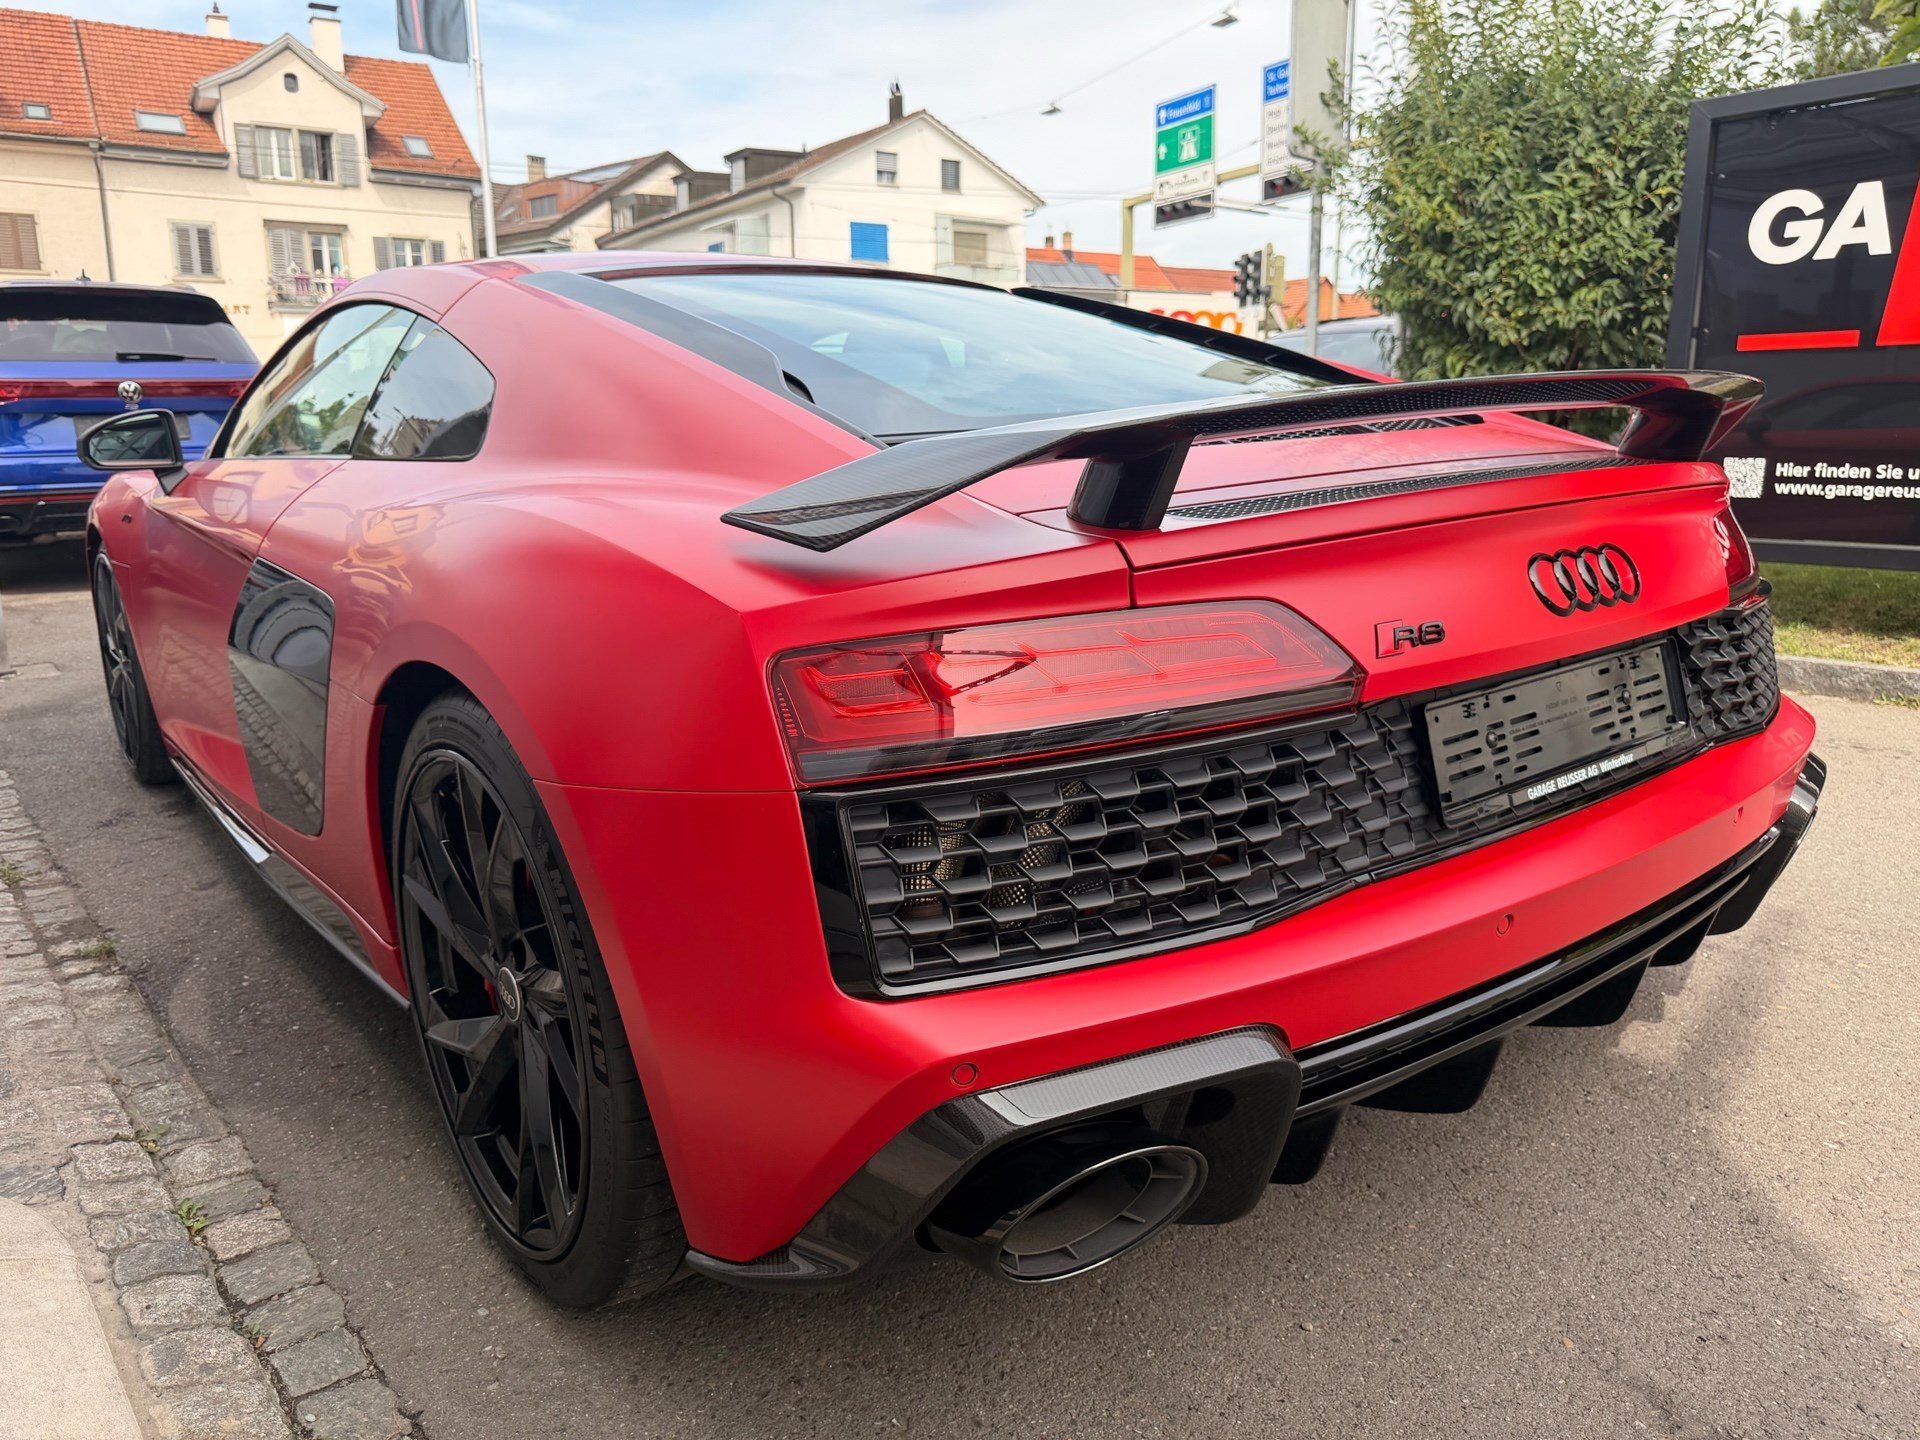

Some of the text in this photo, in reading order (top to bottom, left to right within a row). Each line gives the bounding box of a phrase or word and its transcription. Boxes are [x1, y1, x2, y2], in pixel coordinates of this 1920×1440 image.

[1150, 308, 1243, 335] op
[1775, 462, 1811, 478] Hier
[1814, 462, 1871, 479] finden
[1876, 464, 1903, 480] Sie
[1393, 621, 1446, 651] R8
[1527, 753, 1634, 800] GARAGE REUSSER AG Winterthur
[549, 867, 608, 1073] MICHELIN
